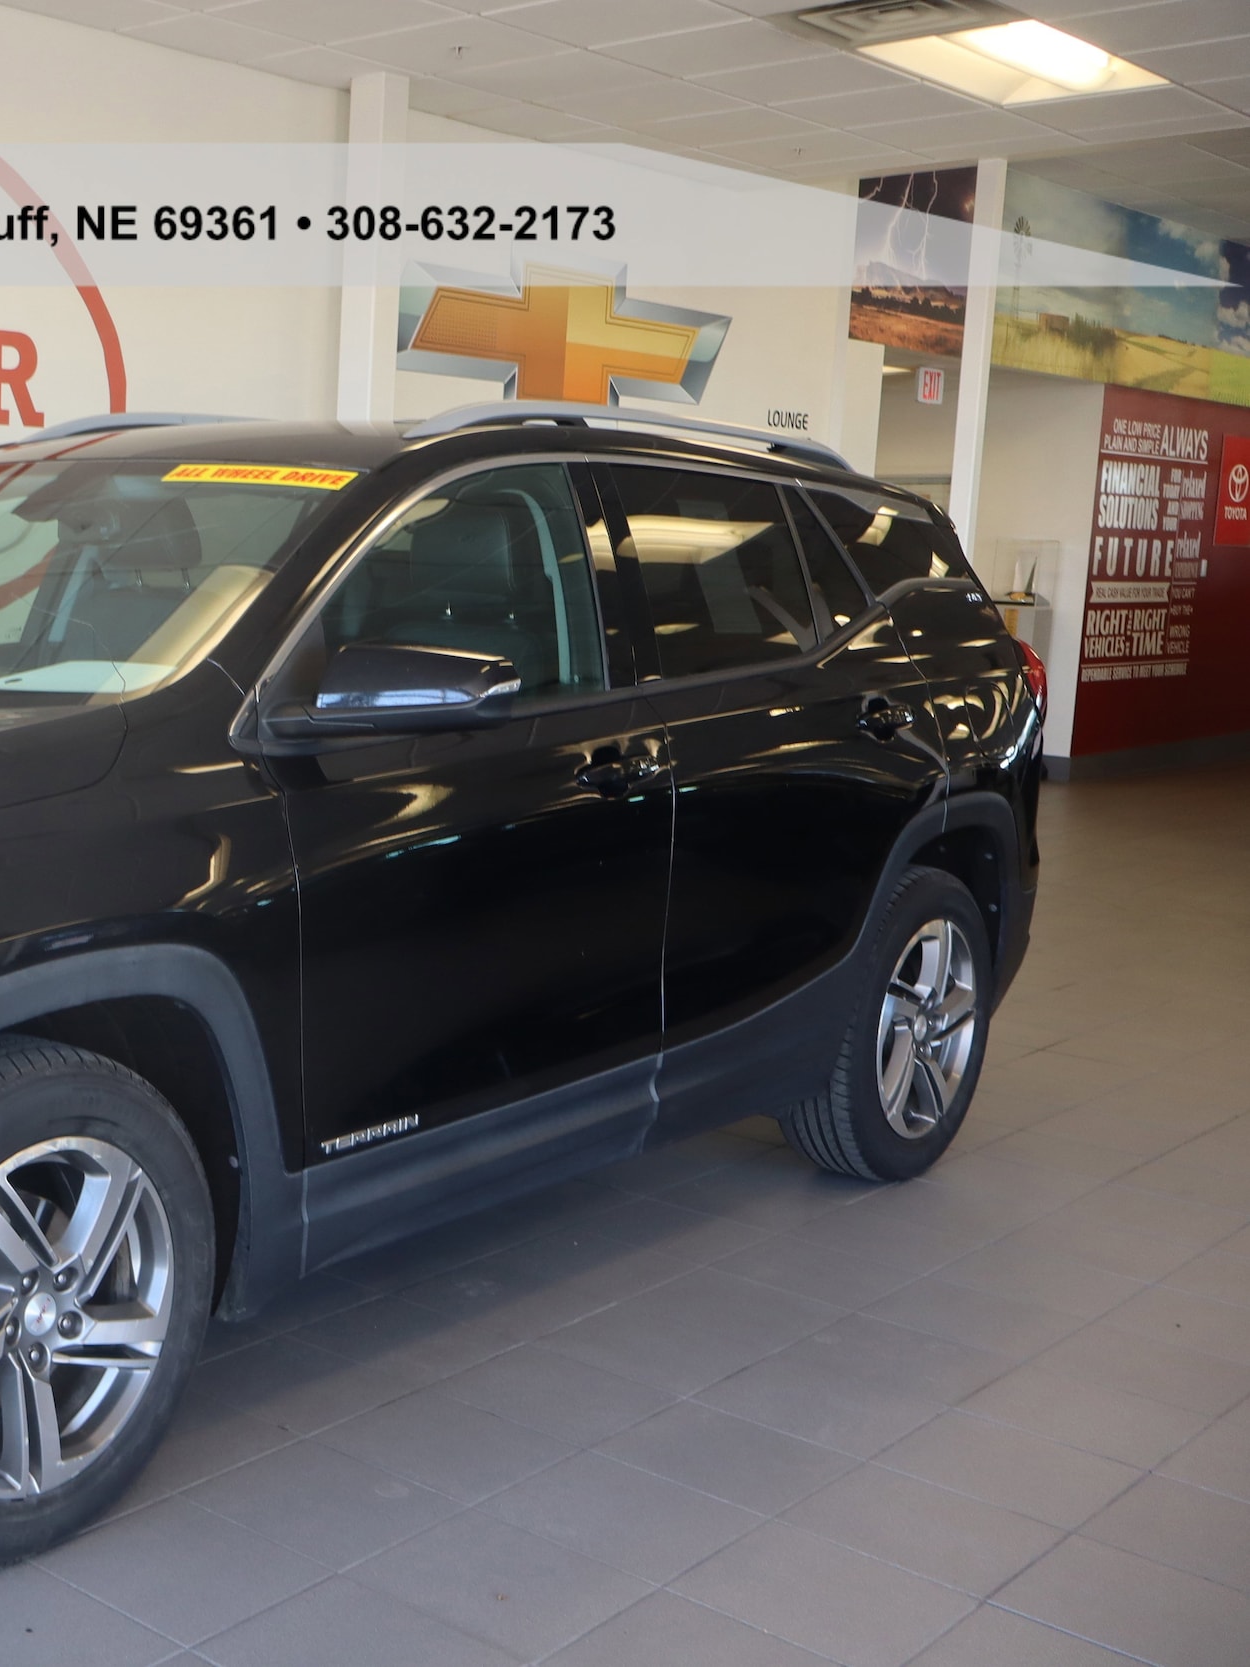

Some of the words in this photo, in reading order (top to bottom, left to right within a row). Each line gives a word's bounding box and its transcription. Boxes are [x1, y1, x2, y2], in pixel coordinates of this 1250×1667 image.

[922, 370, 941, 401] EXIT
[767, 407, 810, 431] LOUNGE
[1113, 418, 1128, 435] ONE
[1128, 420, 1143, 437] LOW
[1143, 421, 1161, 439] PRICE
[1104, 433, 1123, 451] PLAIN
[1123, 436, 1138, 452] AND
[1137, 438, 1161, 456] SIMPLE
[1160, 424, 1209, 461] ALWAYS
[170, 467, 210, 479] ALL
[210, 468, 280, 482] WHEEL
[279, 471, 353, 486] DRIVE
[1100, 460, 1161, 498] FINANCIAL
[1098, 493, 1160, 531] SOLUTIONS
[1224, 505, 1248, 521] TOYOTA
[1092, 535, 1175, 578] FUTURE
[1086, 609, 1129, 637] RIGHT
[1133, 608, 1168, 631] RIGHT
[1084, 635, 1126, 659] VEHICLES
[1132, 631, 1165, 657] TIME
[320, 1113, 419, 1155] TERRAIN
